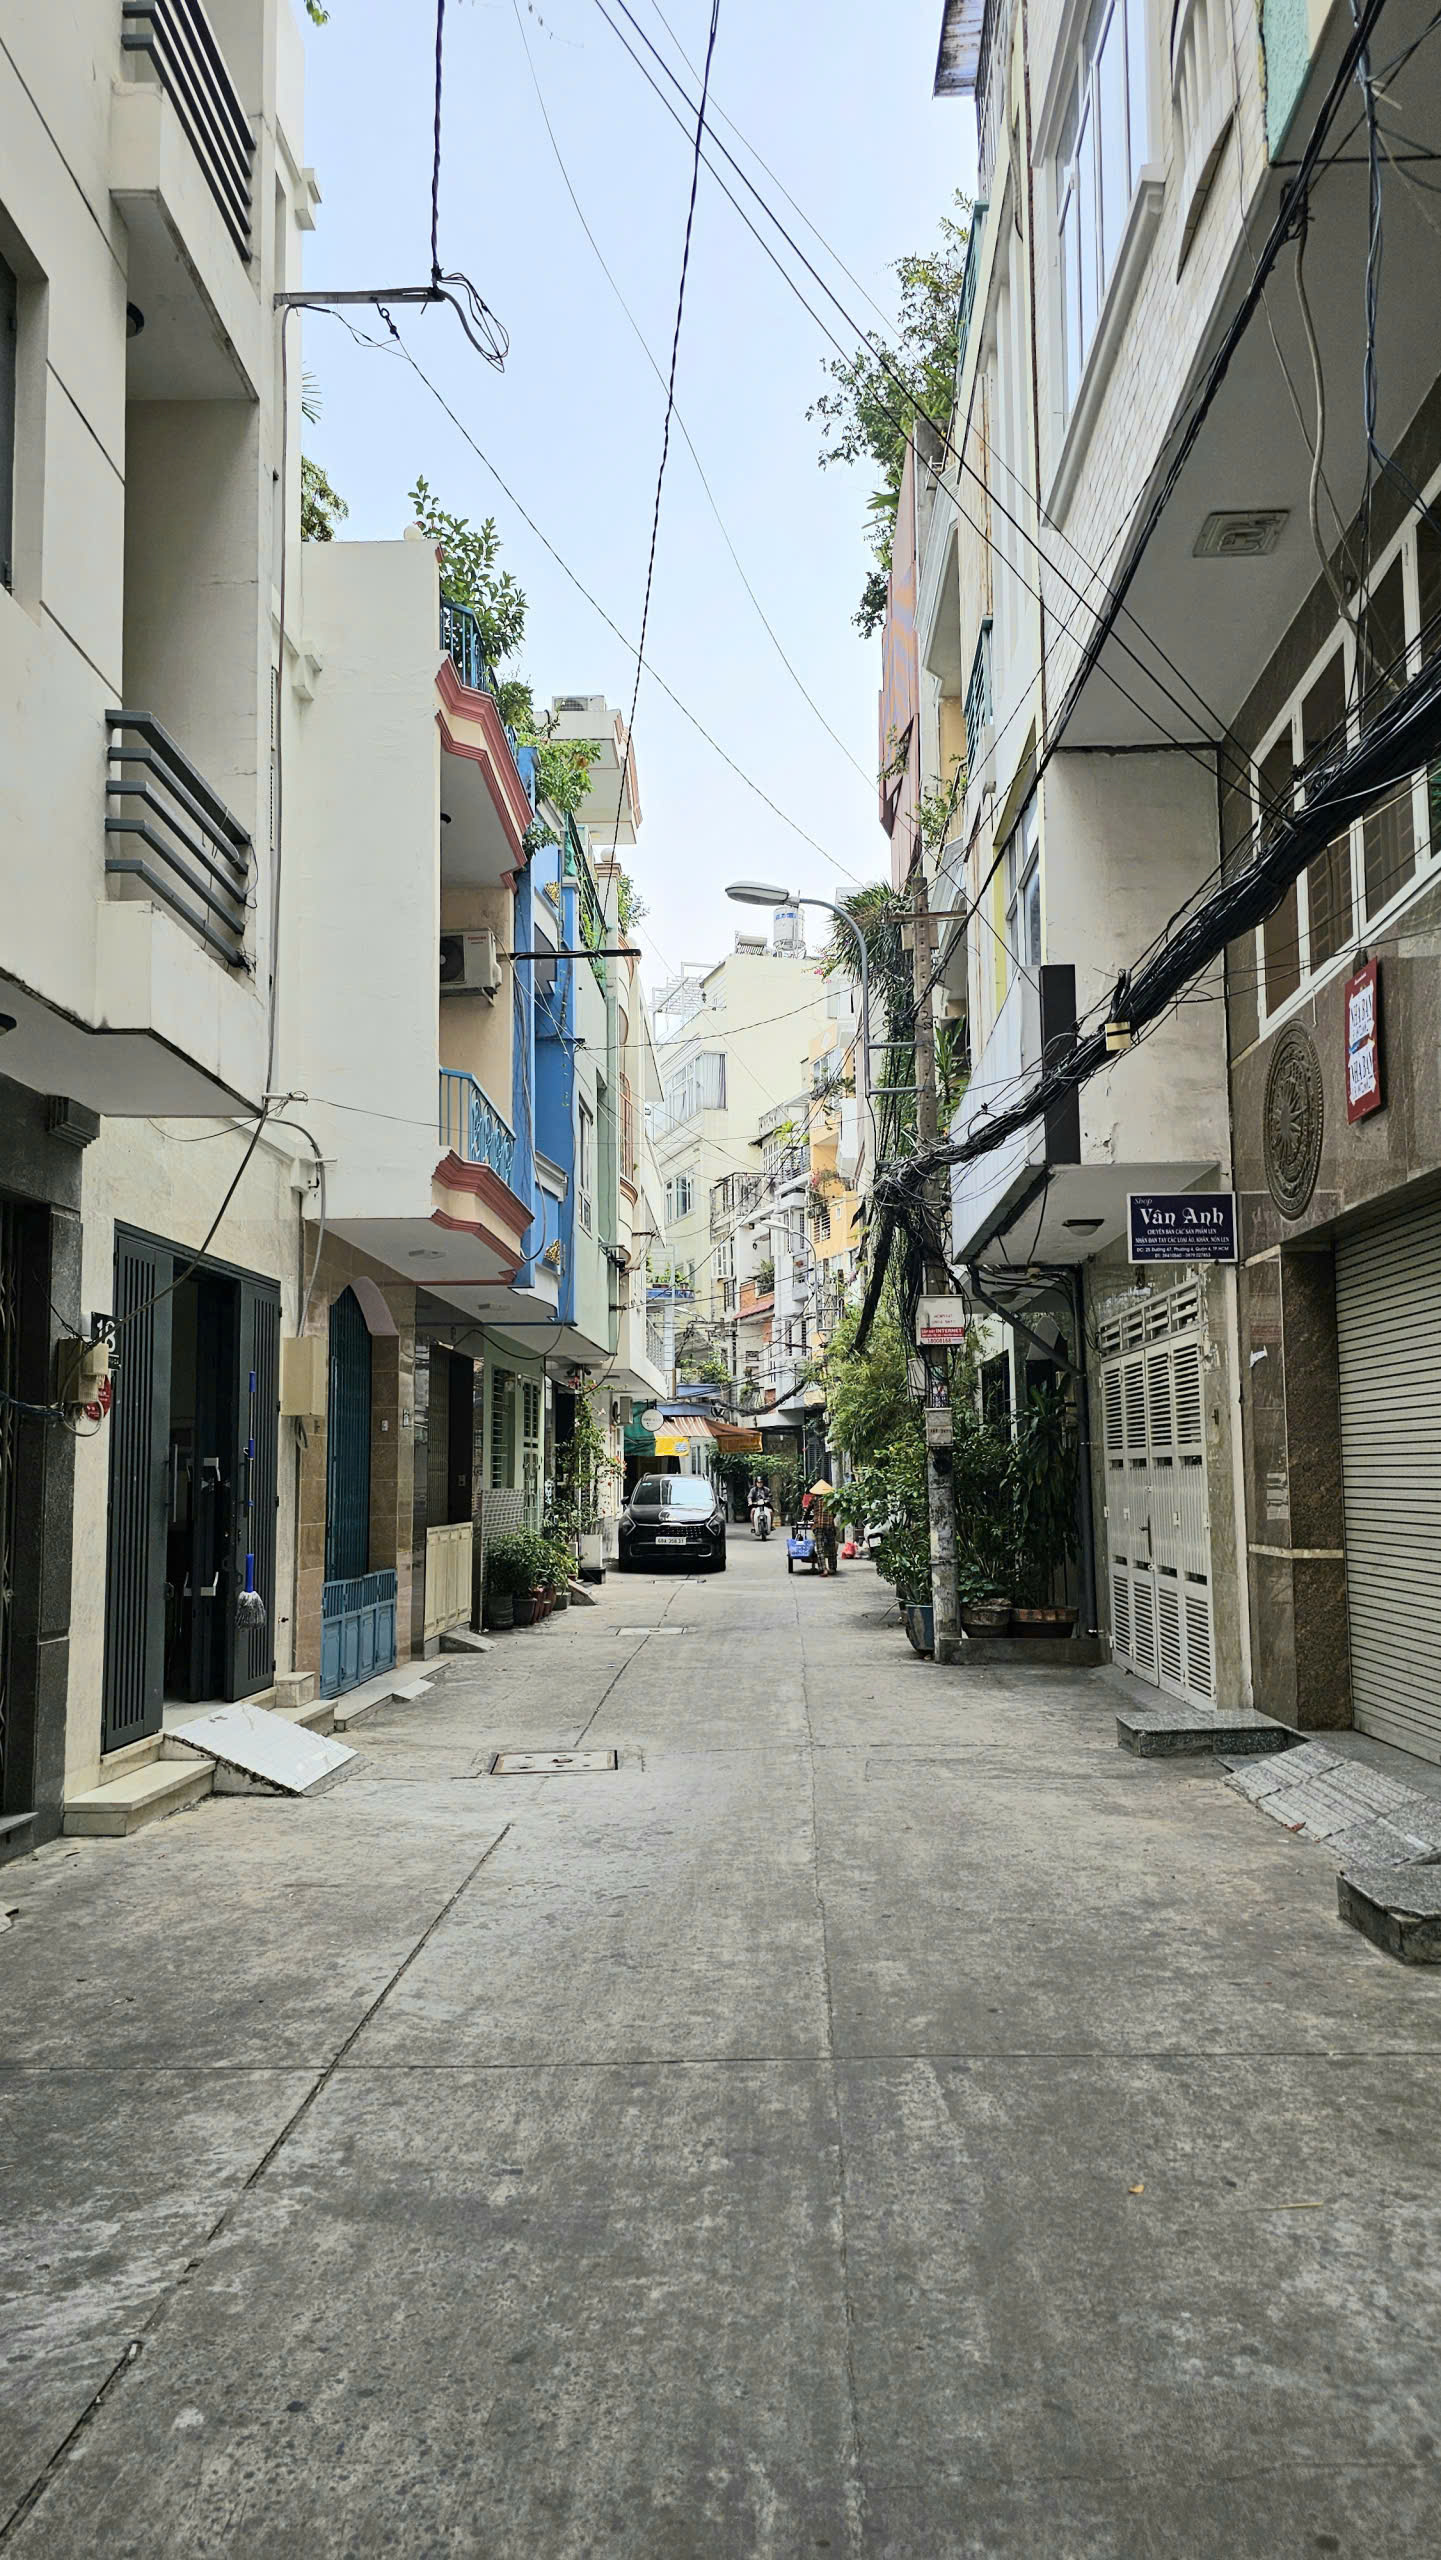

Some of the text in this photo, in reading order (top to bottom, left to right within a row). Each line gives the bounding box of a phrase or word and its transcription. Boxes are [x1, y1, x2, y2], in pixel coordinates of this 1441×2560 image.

[1134, 1198, 1152, 1206] Shop
[1140, 1207, 1224, 1227] Vân Anh
